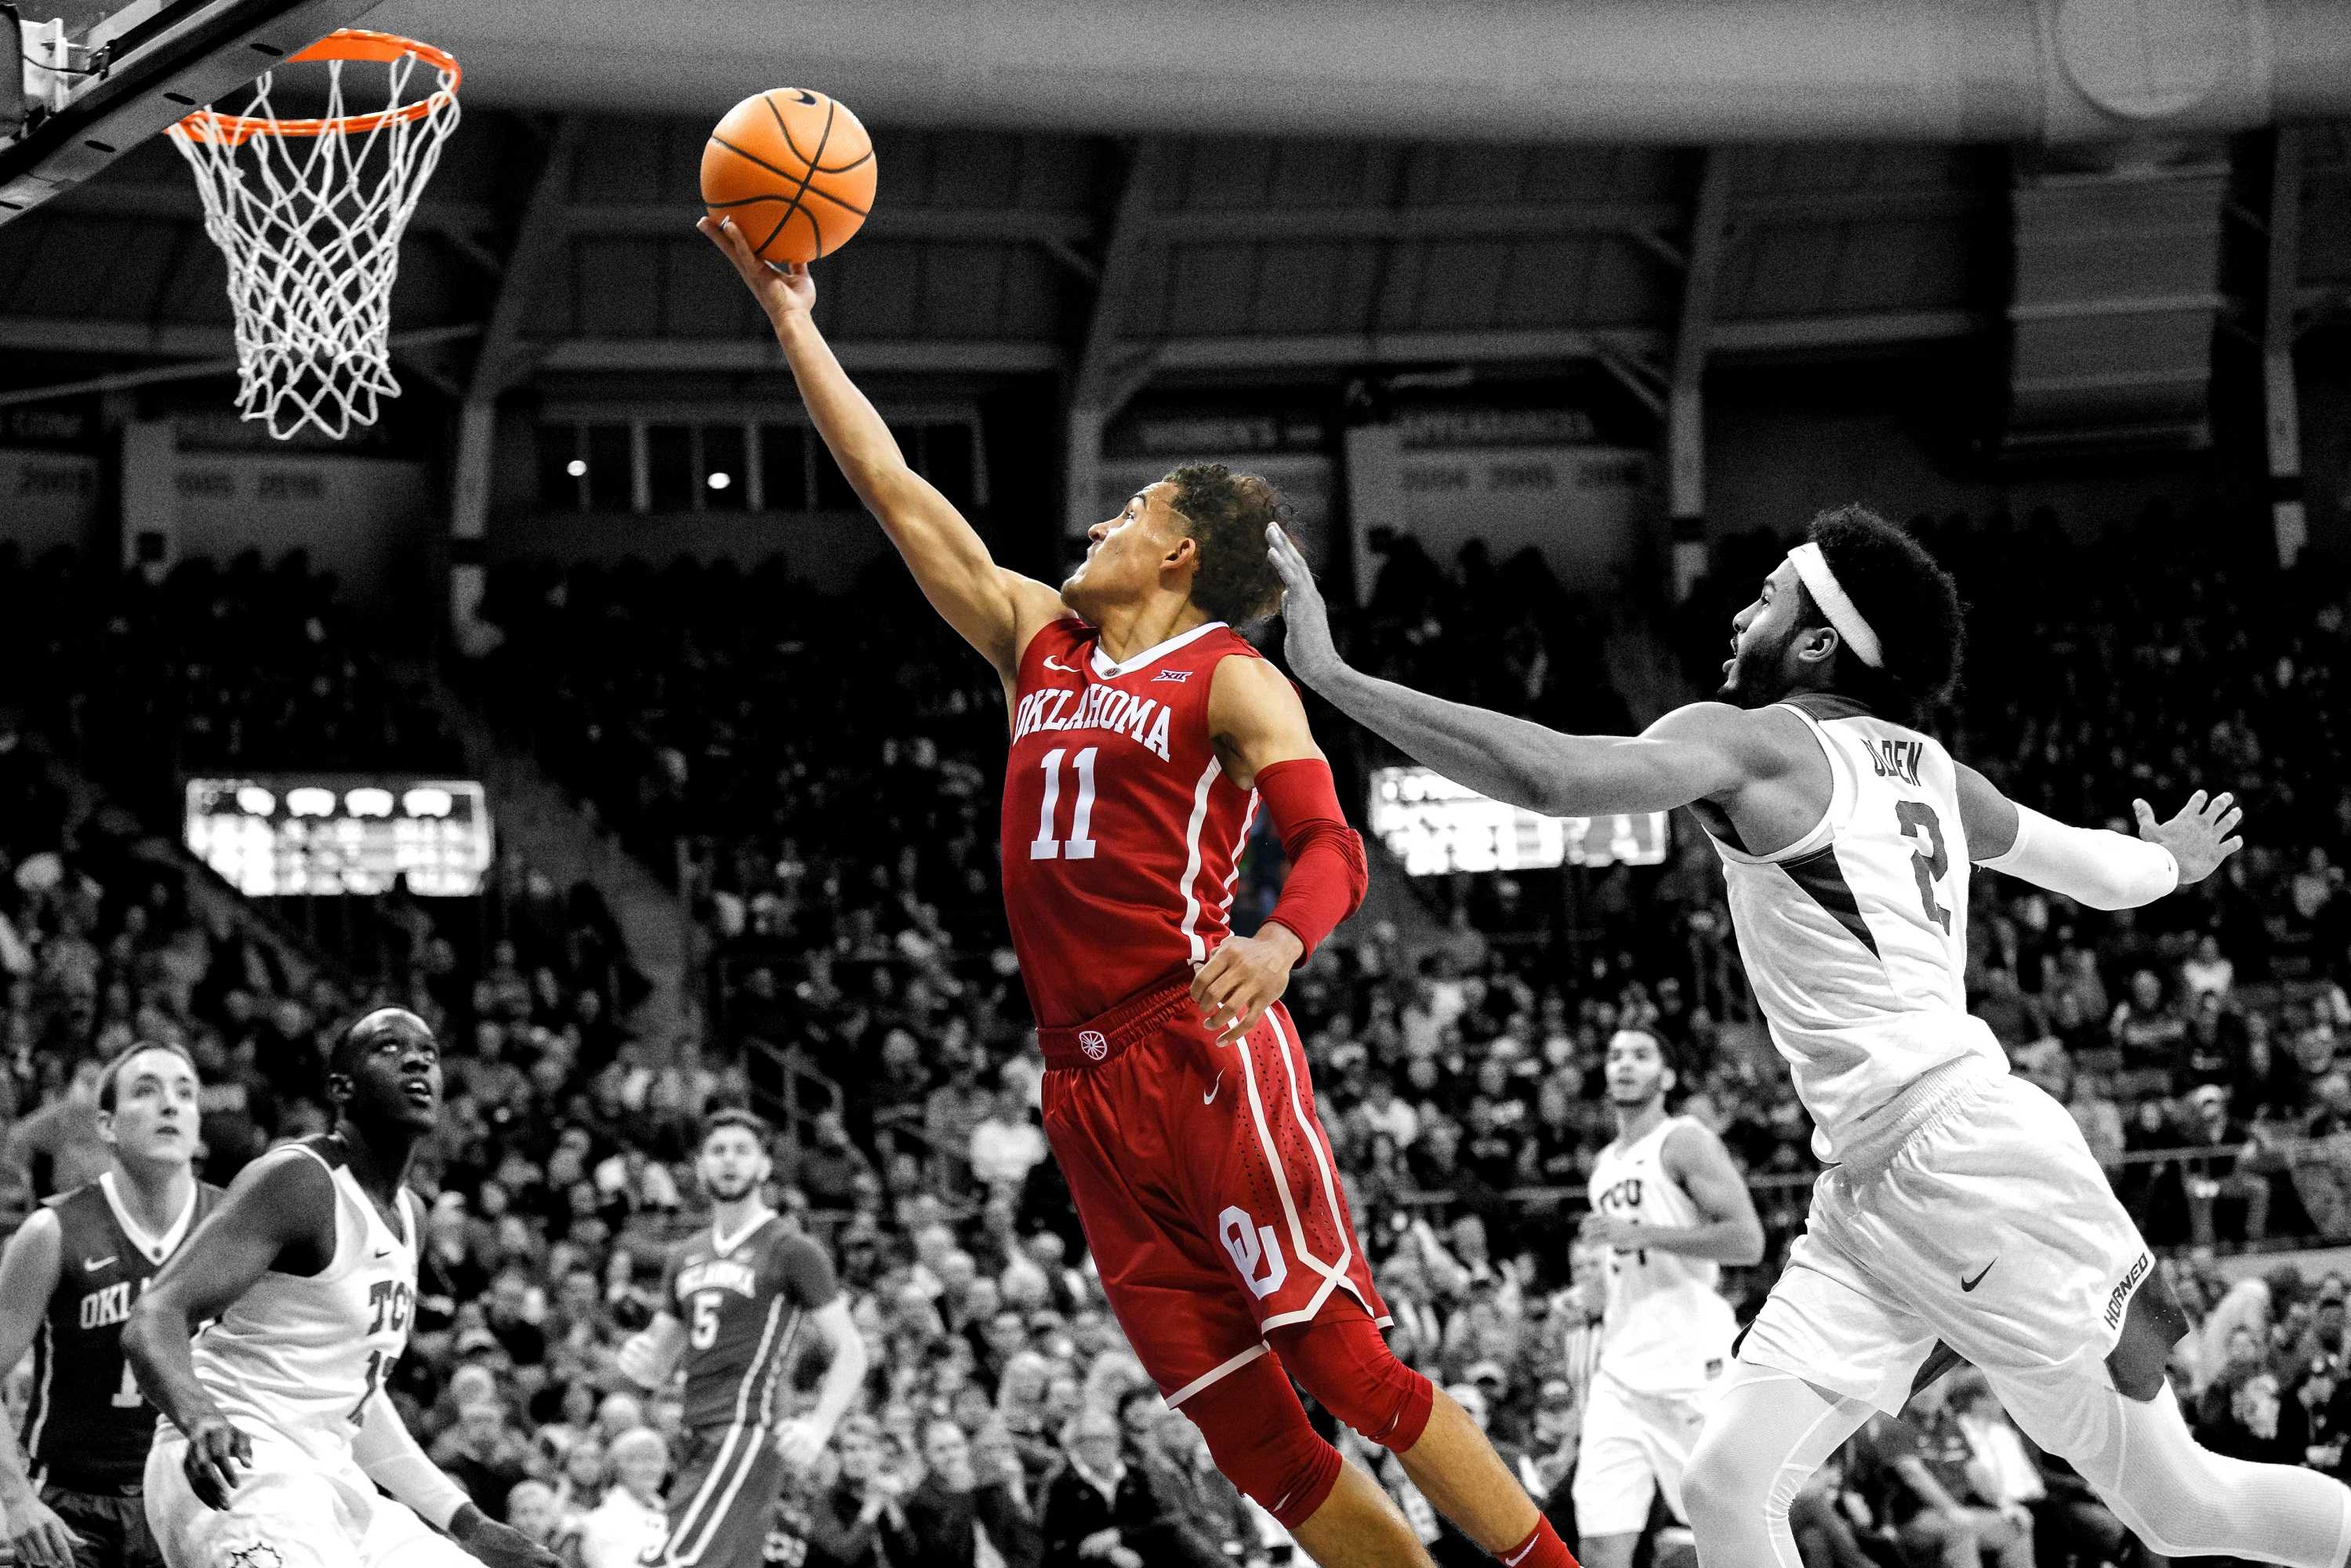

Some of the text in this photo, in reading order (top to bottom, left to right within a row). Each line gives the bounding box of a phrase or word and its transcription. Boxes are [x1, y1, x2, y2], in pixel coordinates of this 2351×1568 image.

[1013, 684, 1171, 763] OKLAHOMA
[1030, 747, 1098, 859] 11
[1895, 800, 1950, 936] 2
[80, 1277, 151, 1330] OKL
[691, 1291, 724, 1350] 5
[2103, 1252, 2148, 1330] HORNED
[348, 1350, 398, 1427] 1
